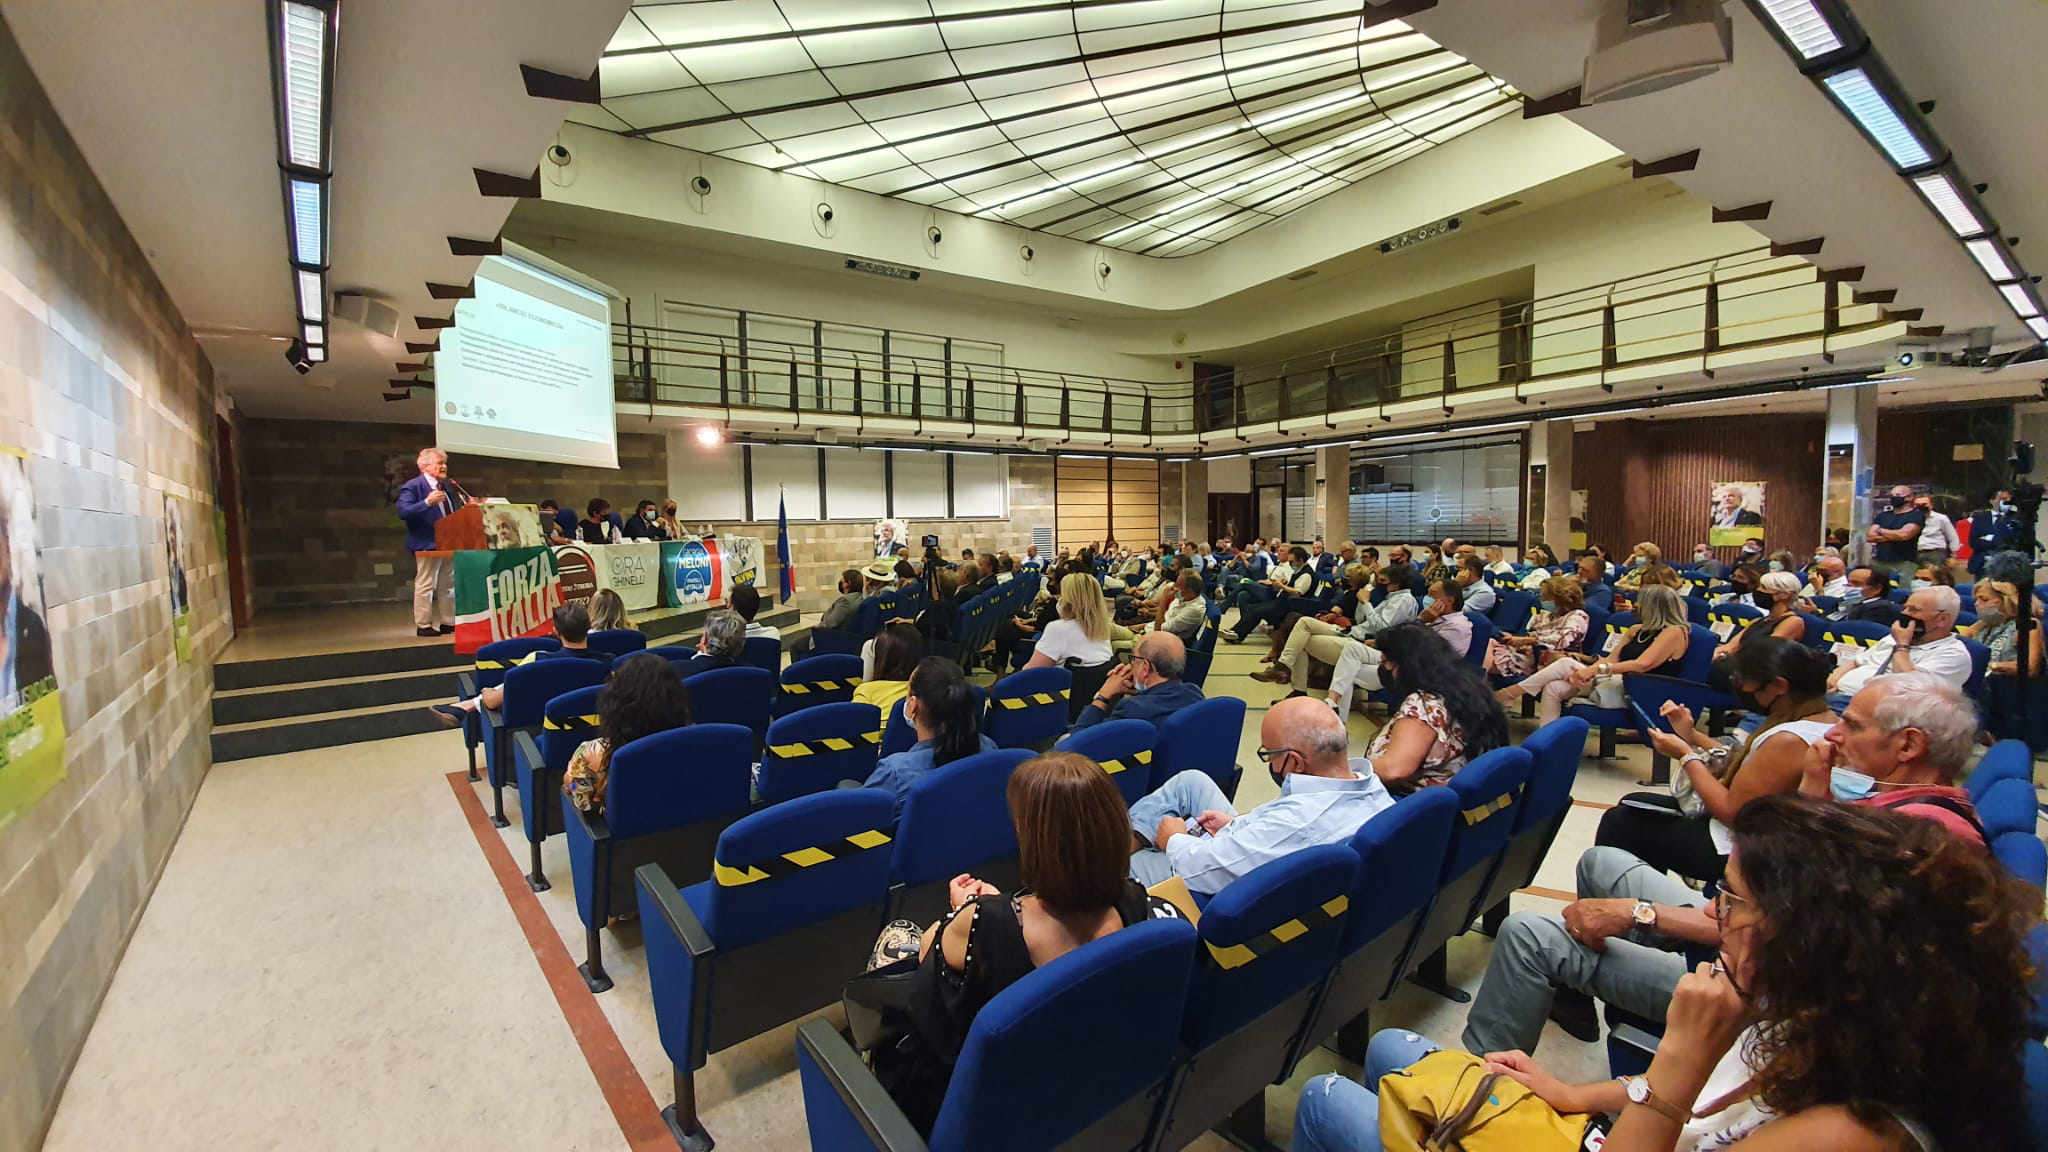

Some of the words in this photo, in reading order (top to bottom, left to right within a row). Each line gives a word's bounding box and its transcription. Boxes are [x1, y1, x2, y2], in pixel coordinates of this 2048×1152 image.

[487, 550, 554, 610] FORZA
[679, 557, 709, 569] MELONI
[490, 575, 562, 643] ITALIA
